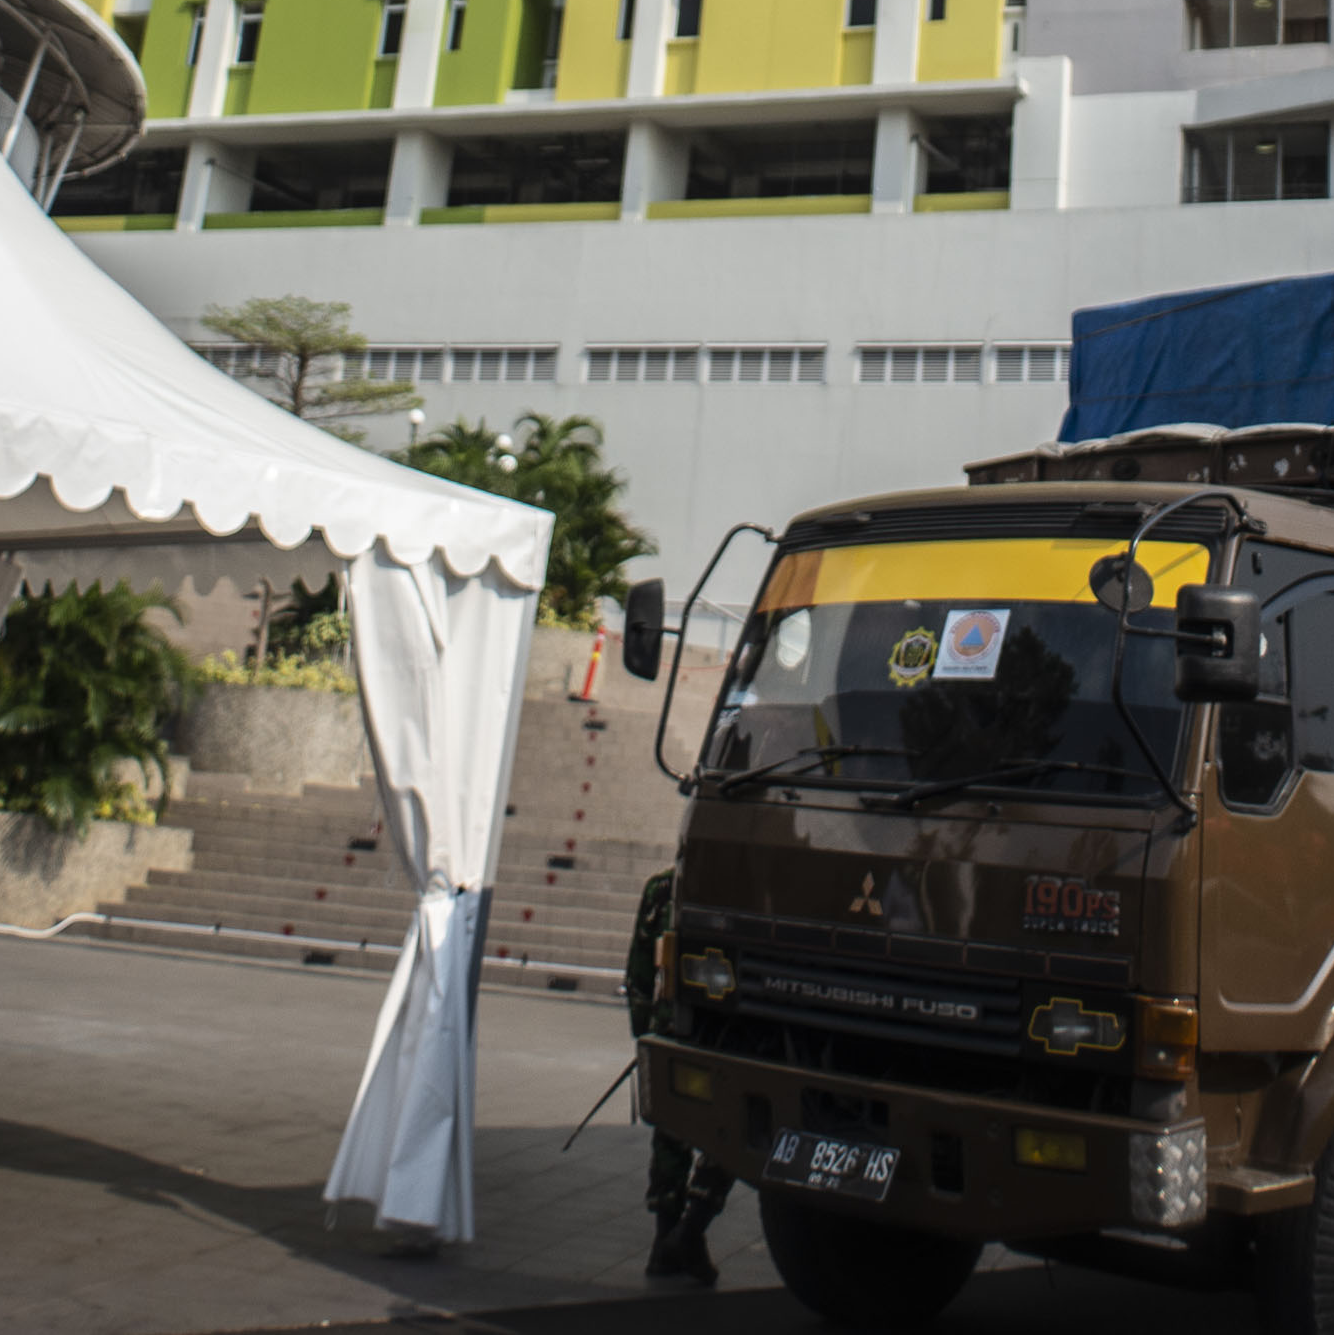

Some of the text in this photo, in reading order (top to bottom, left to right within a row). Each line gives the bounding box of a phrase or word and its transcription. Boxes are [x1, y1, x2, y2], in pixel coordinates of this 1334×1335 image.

[763, 976, 979, 1020] MITSUBISHI FUSO
[772, 1133, 800, 1164] AB
[863, 1147, 894, 1182] HS
